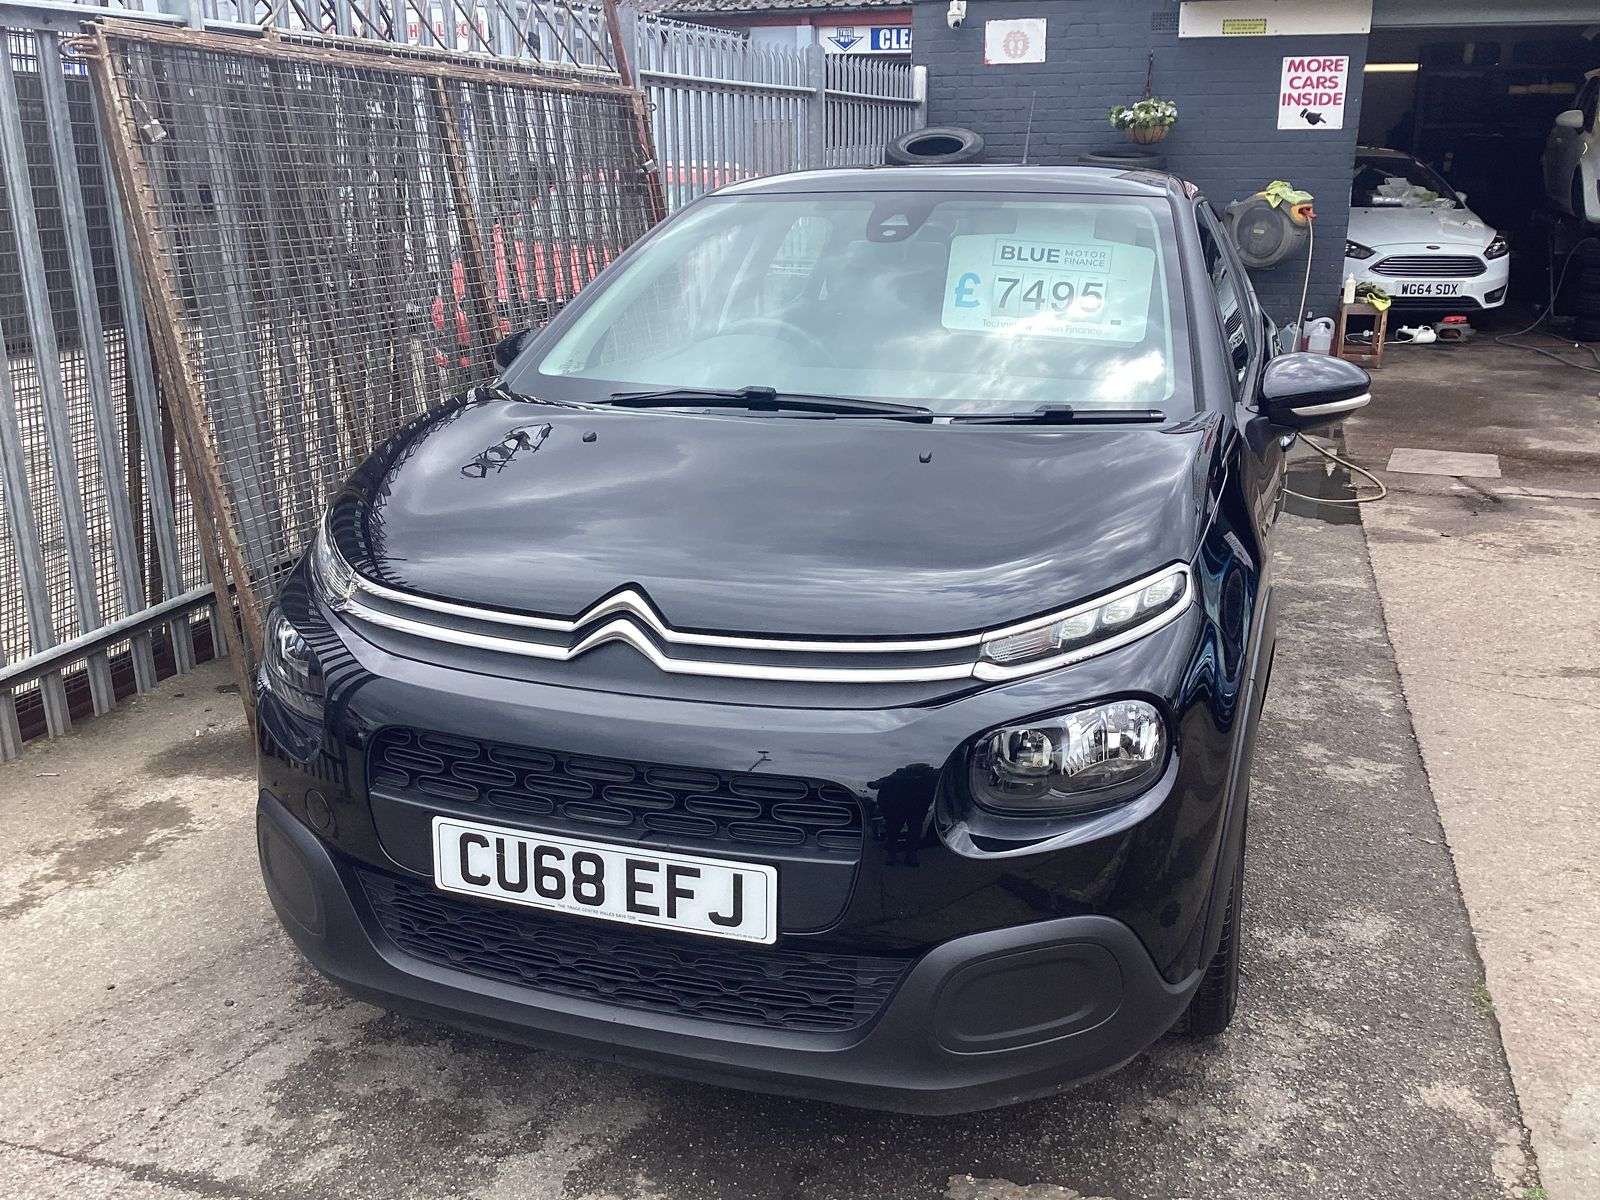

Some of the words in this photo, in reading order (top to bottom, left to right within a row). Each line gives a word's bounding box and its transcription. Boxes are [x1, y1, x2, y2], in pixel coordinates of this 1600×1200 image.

[1287, 58, 1344, 73] MORE
[1289, 75, 1339, 90] CARS
[1282, 92, 1343, 107] INSIDE
[1000, 245, 1060, 264] BLUE
[1064, 249, 1106, 259] MOTOR
[1064, 257, 1105, 267] FINANCE
[1401, 283, 1432, 295] WG64
[1435, 283, 1458, 295] SDX
[459, 832, 605, 907] CU68
